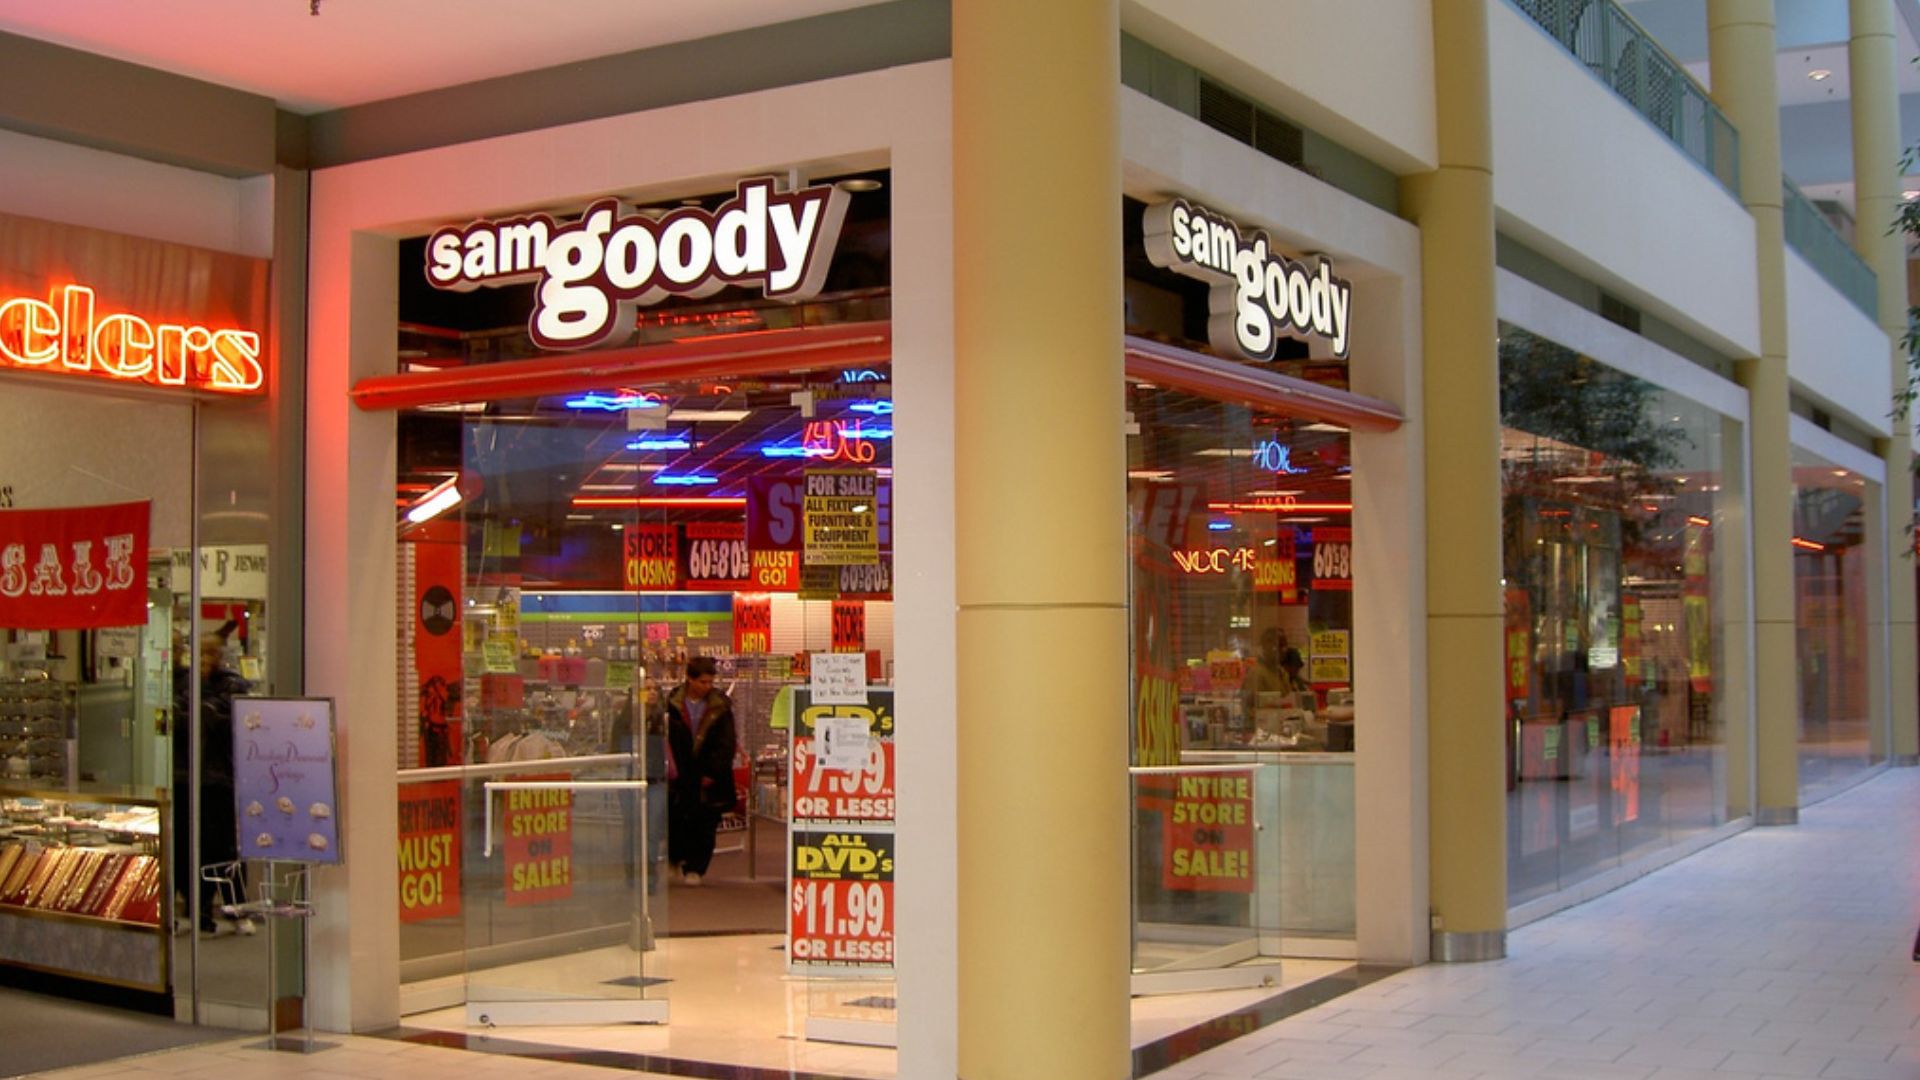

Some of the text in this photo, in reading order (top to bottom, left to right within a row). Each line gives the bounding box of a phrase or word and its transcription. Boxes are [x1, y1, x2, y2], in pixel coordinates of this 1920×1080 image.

[807, 474, 874, 496] FOR SALE
[805, 500, 825, 512] ALL
[628, 533, 673, 557] STORE
[813, 530, 869, 542] EQUIPMENT
[1, 533, 135, 598] SALE
[754, 551, 794, 567] MUST
[627, 559, 676, 586] CLOSING
[759, 570, 787, 586] GO!
[509, 788, 569, 810] ENTIRE
[1177, 777, 1248, 799] NTIRE
[796, 797, 894, 818] OR LESS!
[1173, 803, 1246, 824] STORE
[512, 811, 568, 837] STORE
[822, 834, 867, 846] ALL
[1193, 829, 1225, 844] ON
[398, 834, 452, 871] MUST
[797, 846, 893, 872] DVD's
[1172, 848, 1249, 878] SALE!
[512, 856, 569, 891] SALE!
[402, 871, 443, 909] GO!
[794, 881, 884, 937] $11.99
[793, 937, 893, 960] OR LESS!
